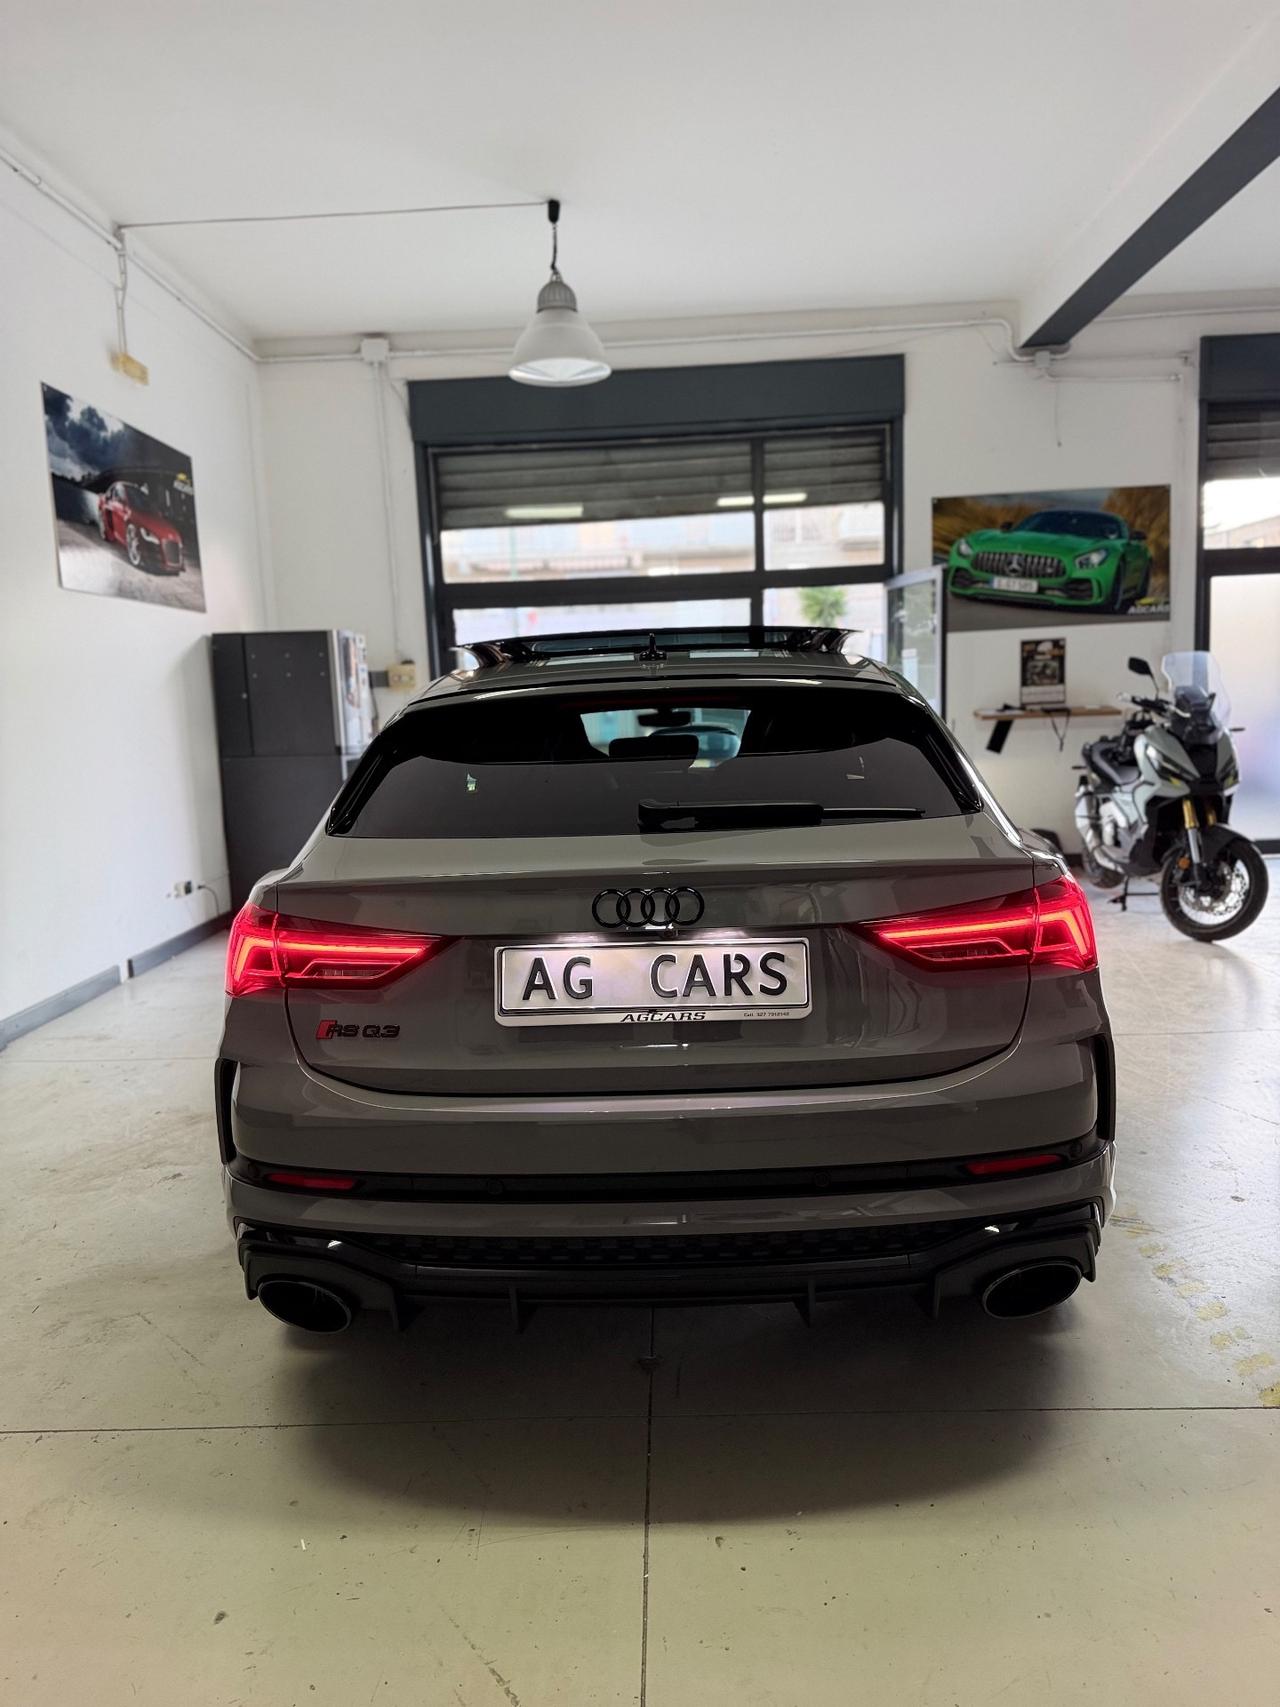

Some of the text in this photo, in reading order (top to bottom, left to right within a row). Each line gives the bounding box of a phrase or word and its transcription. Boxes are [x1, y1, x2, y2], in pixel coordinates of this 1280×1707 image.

[522, 952, 787, 1000] AG CARS
[620, 1012, 706, 1022] AGCARS
[319, 1021, 400, 1038] RS Q3
